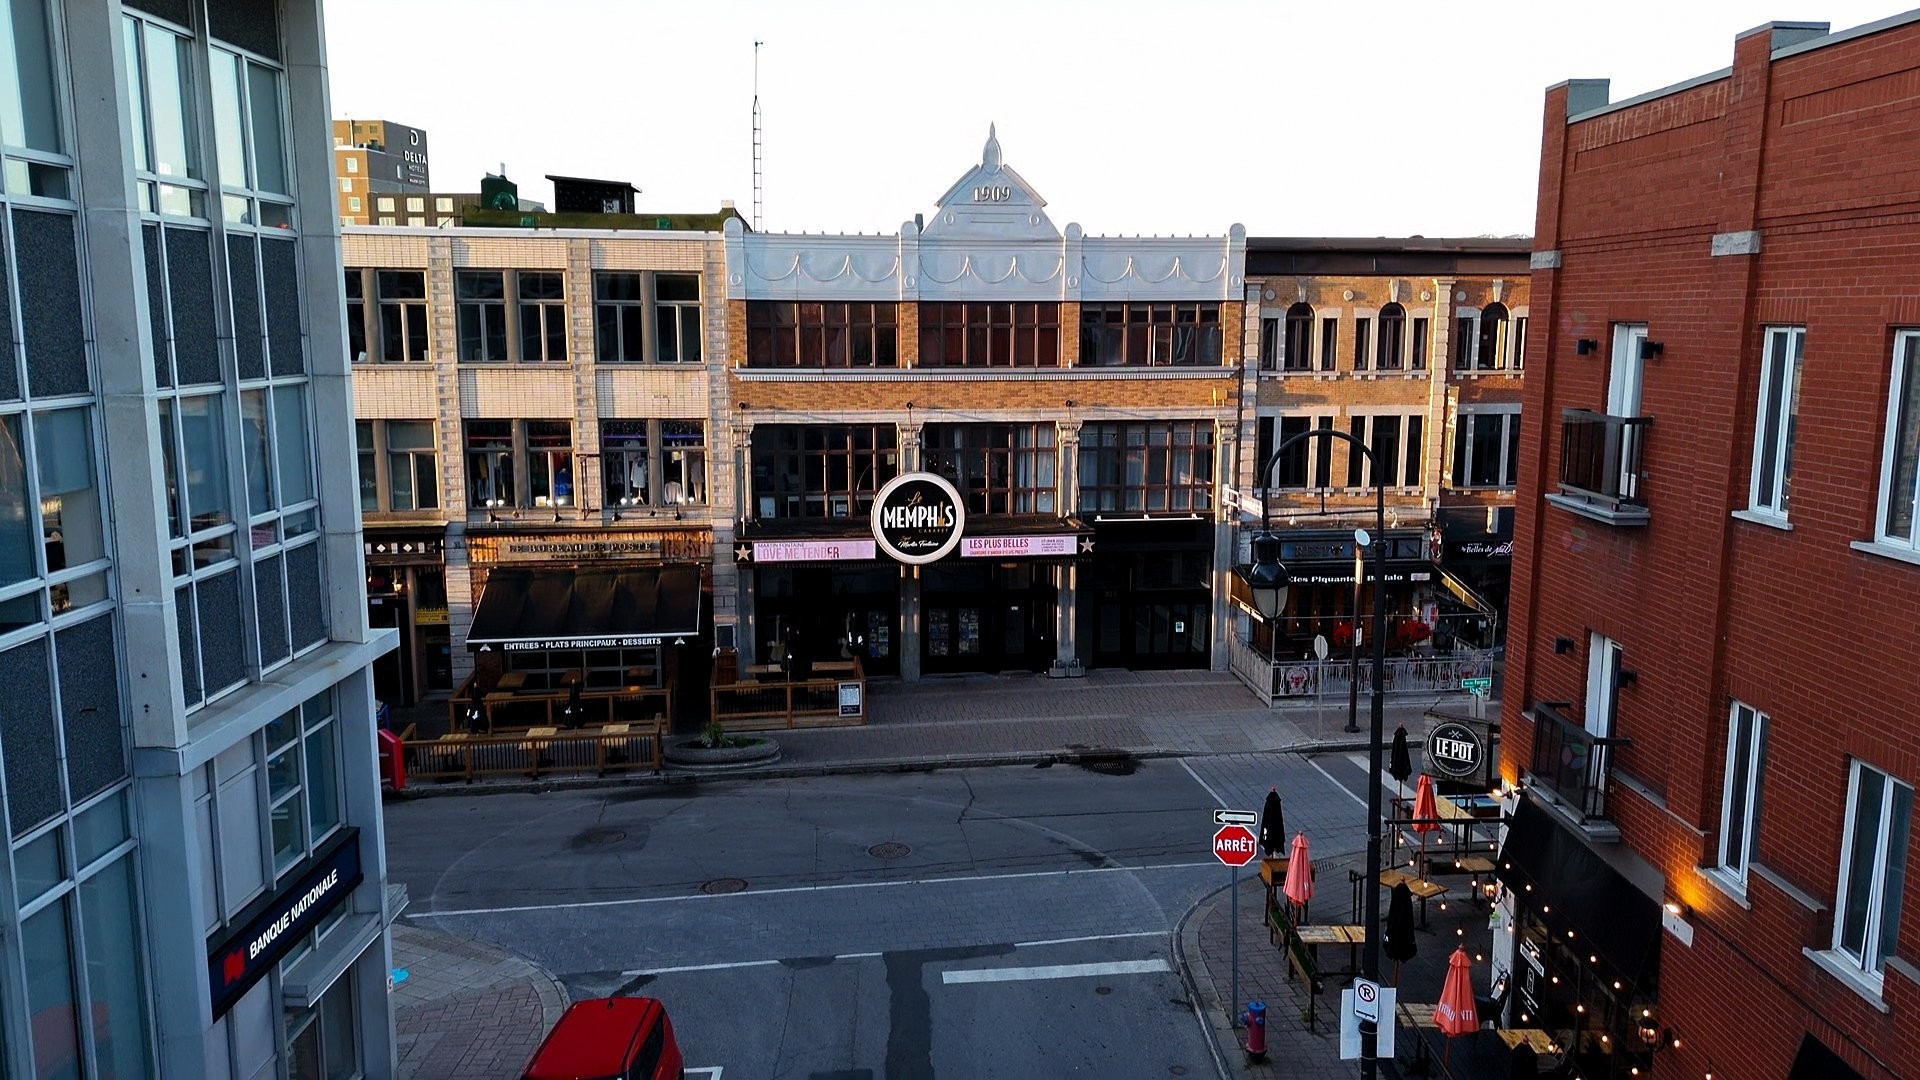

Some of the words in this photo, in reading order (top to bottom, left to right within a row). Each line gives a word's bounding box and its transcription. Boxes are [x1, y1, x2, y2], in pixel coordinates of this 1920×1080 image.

[404, 150, 427, 165] DELTA
[974, 186, 1011, 202] 1909
[907, 491, 923, 507] Le
[883, 501, 954, 529] MEMPHIS
[588, 543, 605, 551] DE
[610, 542, 652, 551] POSTE
[969, 539, 983, 549] LES
[984, 538, 1002, 549] PLUS
[1003, 538, 1029, 548] BELLES
[757, 546, 780, 560] LOVE
[785, 547, 800, 560] ME
[803, 546, 840, 559] TENDER
[545, 640, 569, 649] PLATS
[571, 639, 617, 648] PRINCIPAUX
[622, 637, 662, 646] DESSERTS
[1436, 739, 1449, 756] LE
[1451, 741, 1474, 761] POT
[1216, 836, 1254, 853] ARRÊT
[249, 912, 290, 960] BANQUE
[291, 868, 338, 922] NATIONALE
